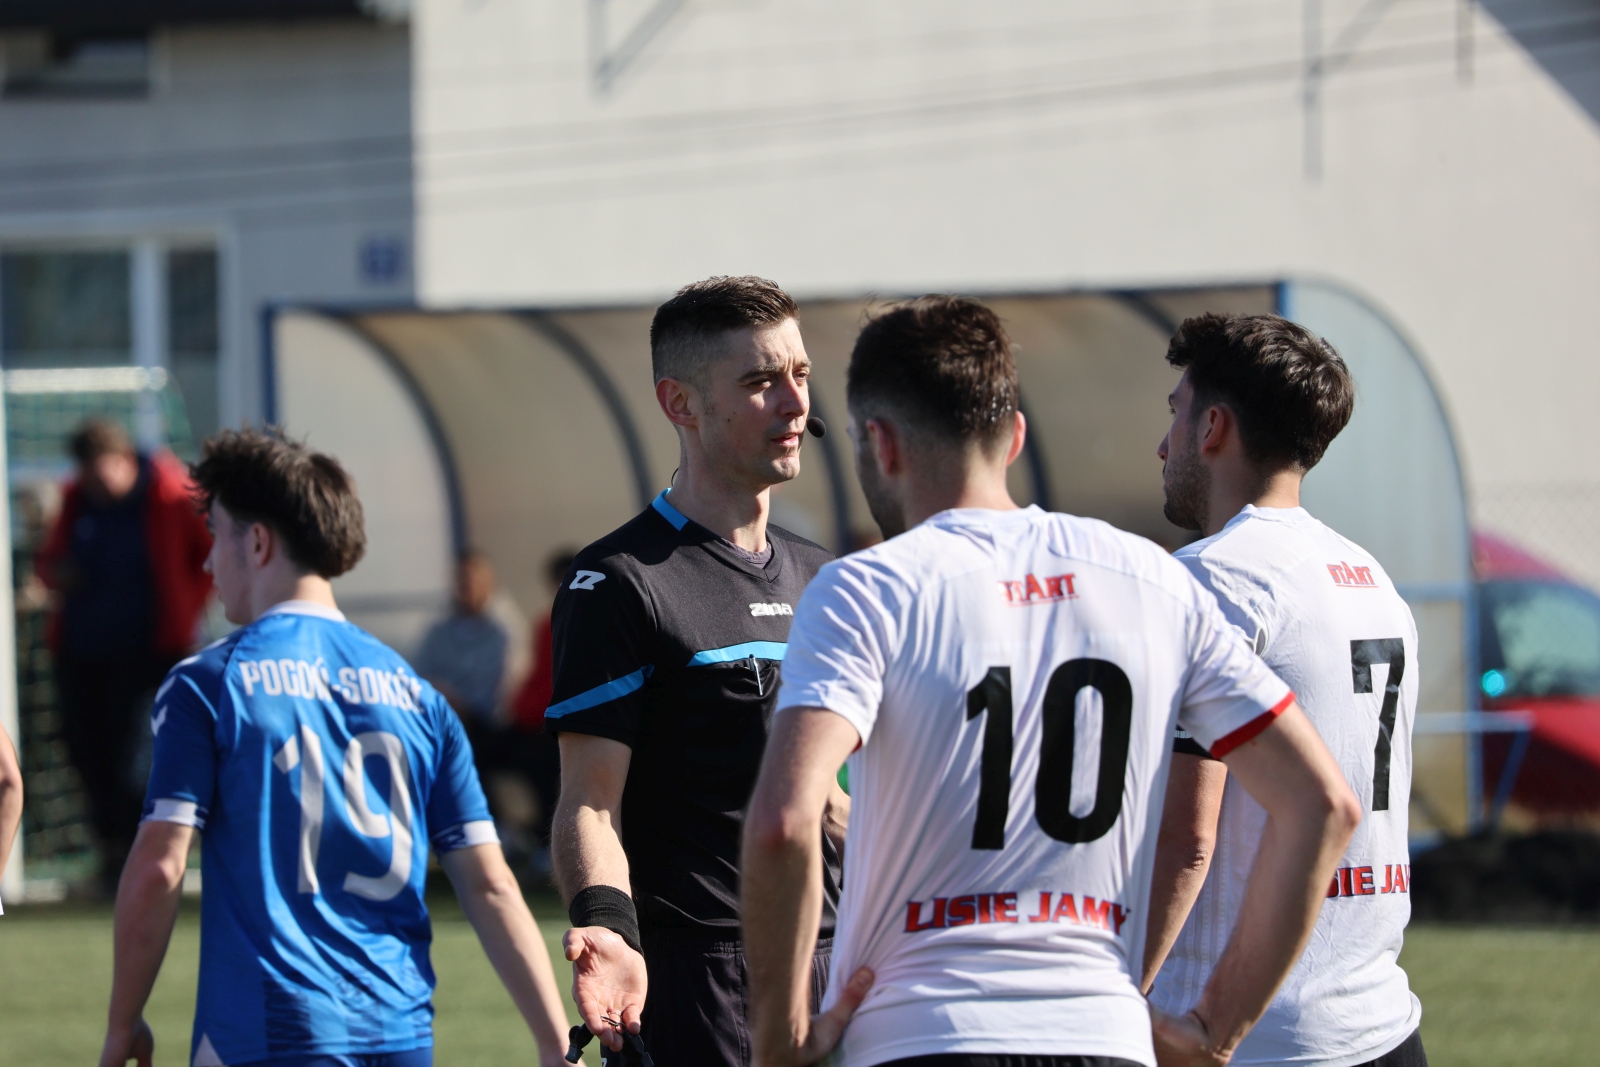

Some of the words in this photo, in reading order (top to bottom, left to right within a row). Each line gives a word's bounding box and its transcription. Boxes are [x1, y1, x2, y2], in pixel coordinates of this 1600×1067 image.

[966, 657, 1133, 850] 10
[1350, 637, 1405, 811] 7
[273, 724, 413, 901] 19
[904, 892, 1019, 933] LISIE
[1028, 892, 1131, 936] JAMY
